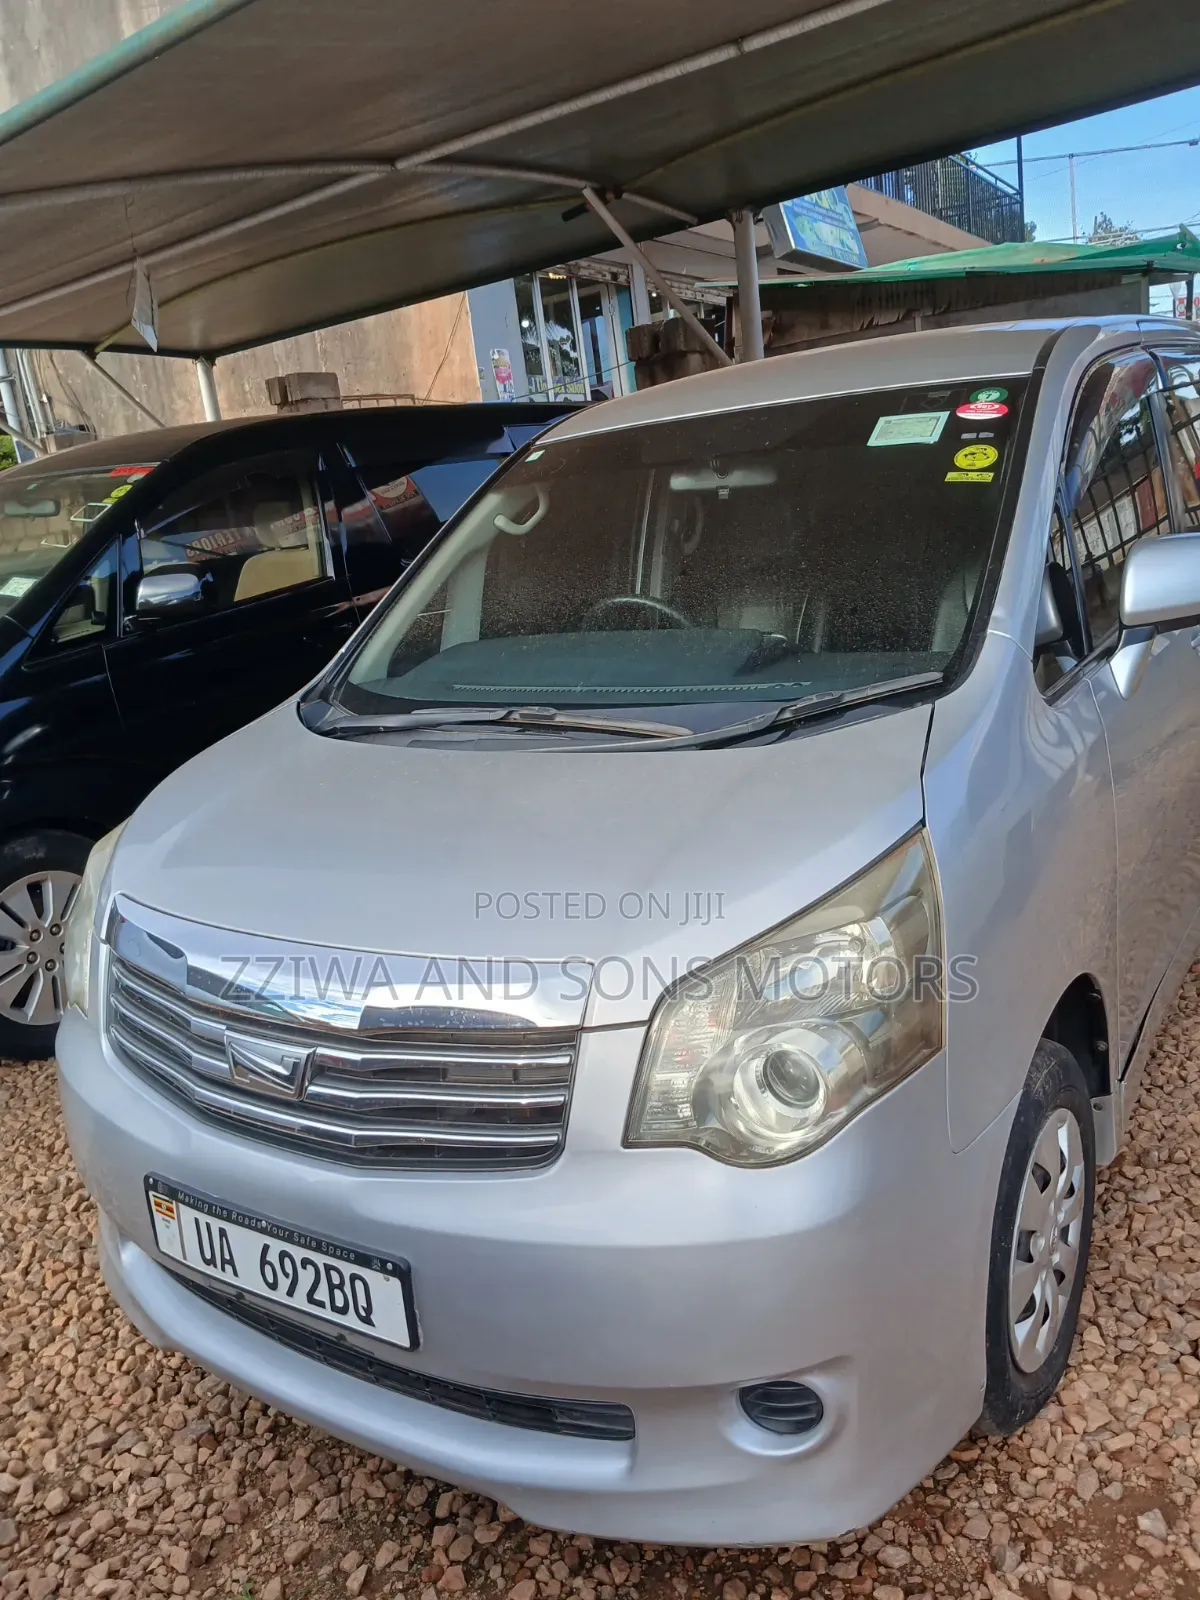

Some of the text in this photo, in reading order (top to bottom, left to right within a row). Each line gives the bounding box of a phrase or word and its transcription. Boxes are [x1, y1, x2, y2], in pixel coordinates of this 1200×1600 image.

[177, 1191, 356, 1261] Making the Roads Your Safe Space
[194, 1217, 376, 1327] UA 692BQ
